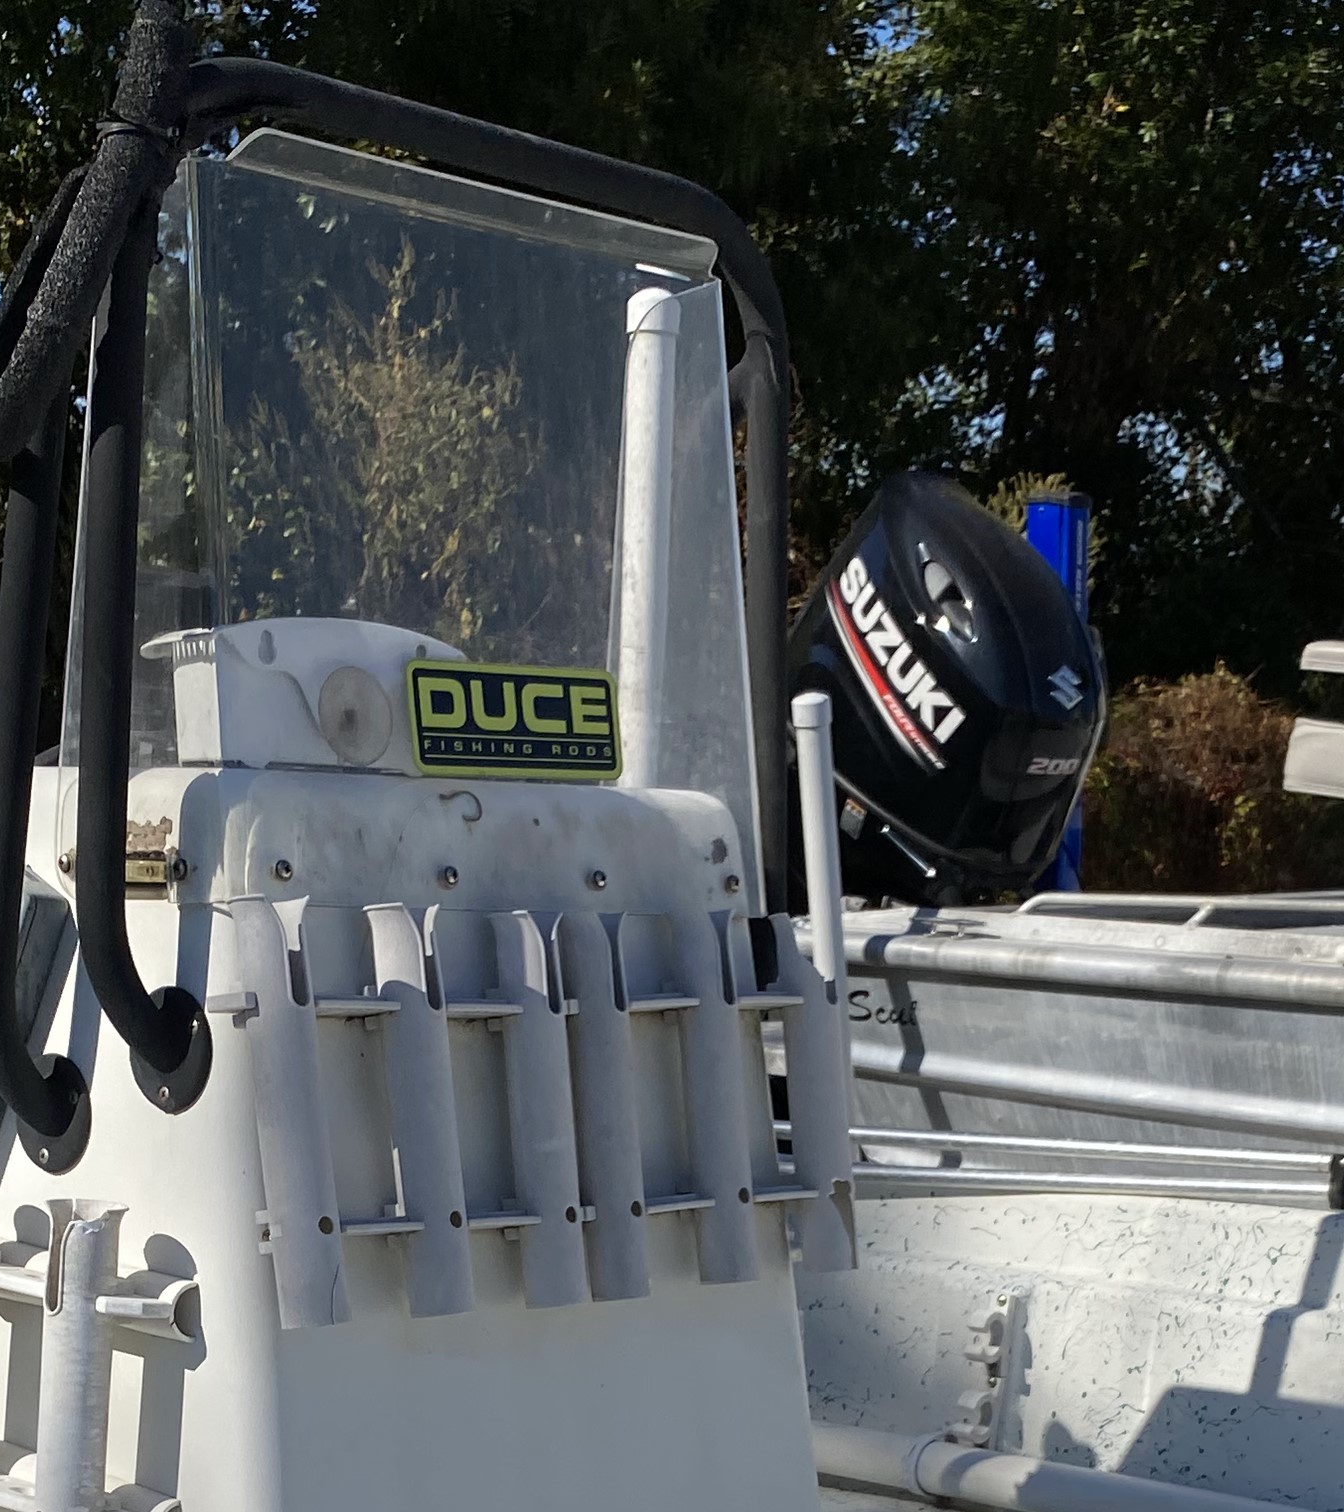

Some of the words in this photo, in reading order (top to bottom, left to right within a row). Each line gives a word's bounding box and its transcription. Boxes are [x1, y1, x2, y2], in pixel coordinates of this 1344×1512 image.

[840, 557, 967, 745] SUZUKI
[418, 677, 611, 736] DUCE
[424, 740, 533, 756] FISHING
[552, 744, 612, 757] RODS
[1026, 757, 1081, 776] 200
